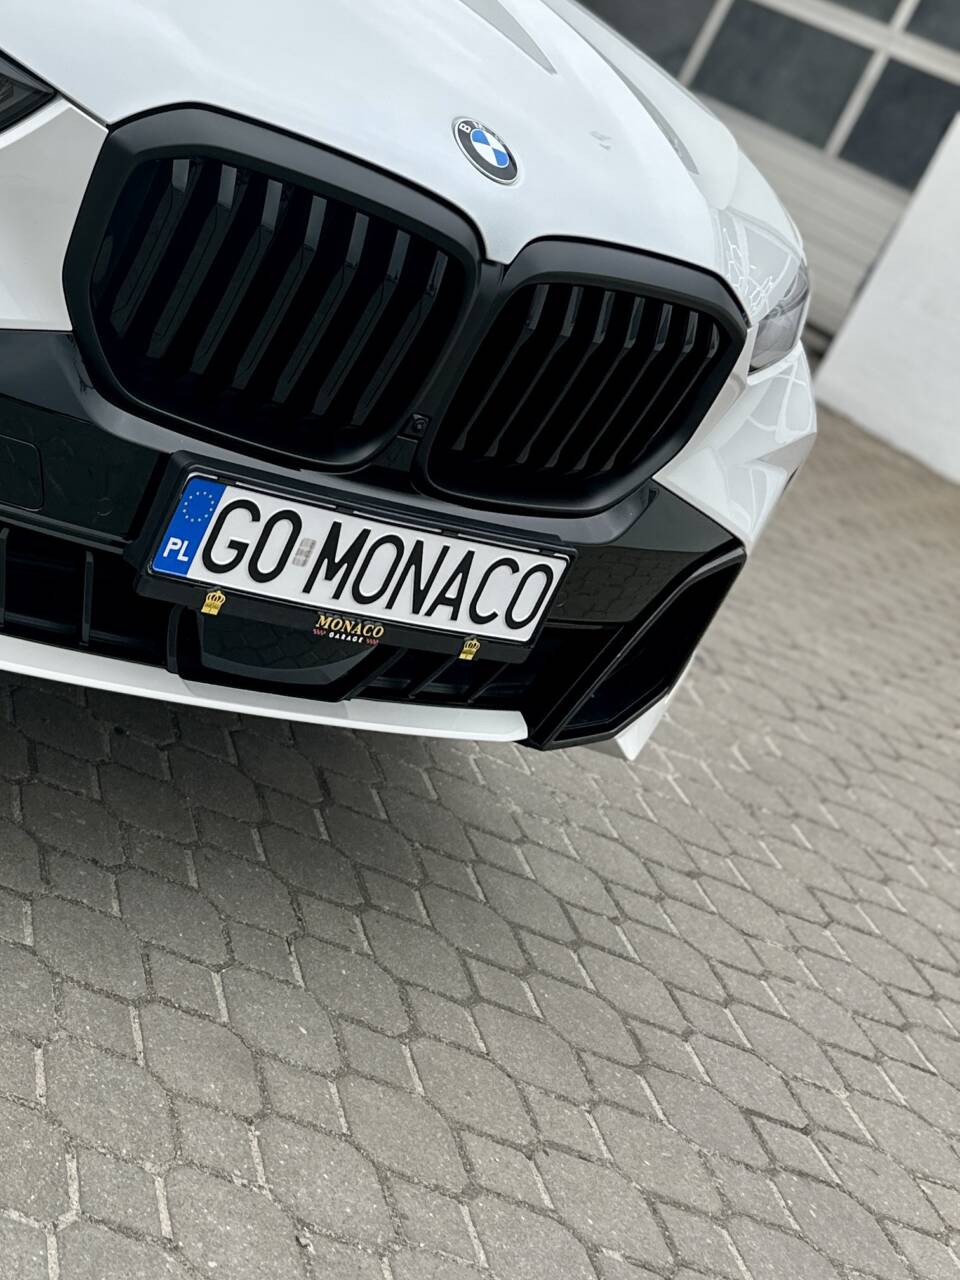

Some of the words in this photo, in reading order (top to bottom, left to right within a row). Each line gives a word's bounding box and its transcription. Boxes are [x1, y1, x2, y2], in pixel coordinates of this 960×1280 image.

[163, 537, 189, 562] PL
[202, 499, 302, 583] GO
[302, 521, 554, 630] MONACO
[315, 615, 385, 638] MONACO
[328, 631, 364, 643] GARAGE
